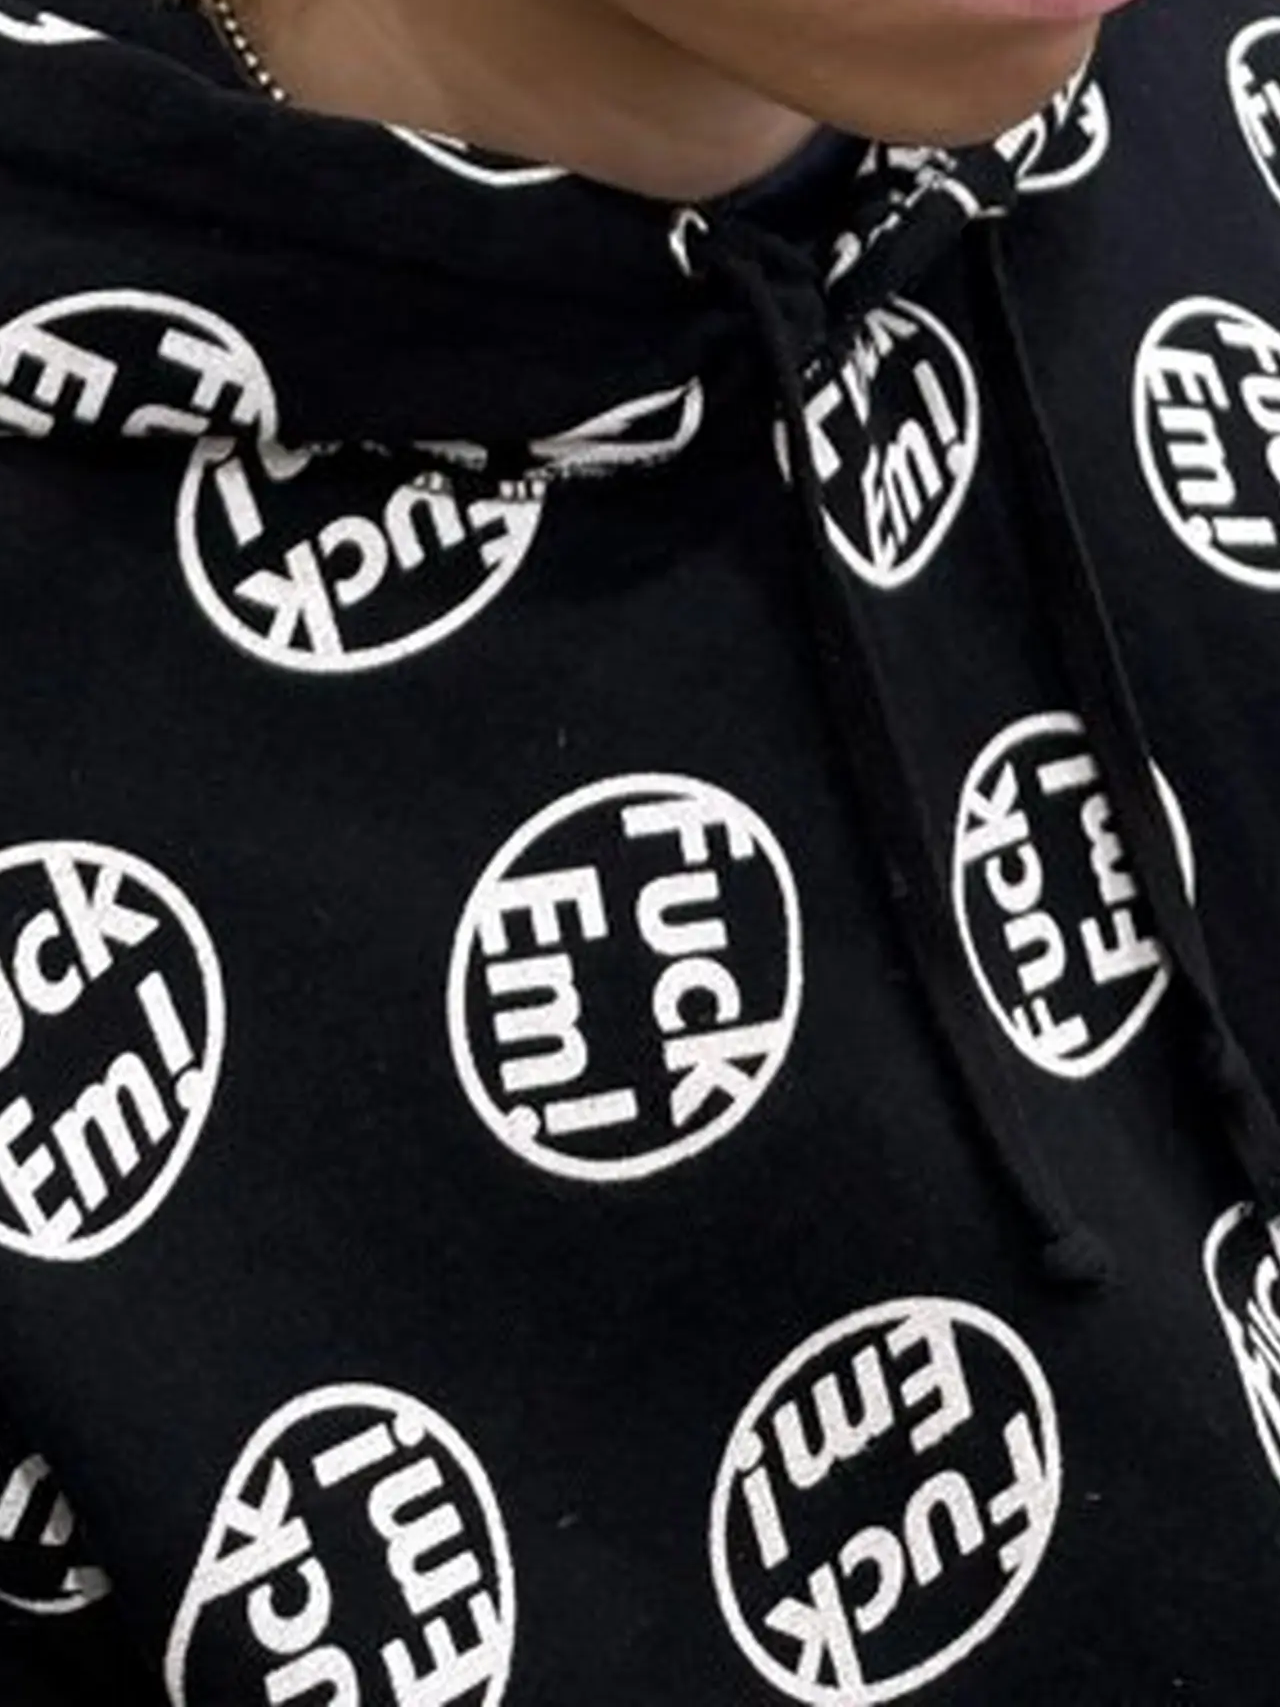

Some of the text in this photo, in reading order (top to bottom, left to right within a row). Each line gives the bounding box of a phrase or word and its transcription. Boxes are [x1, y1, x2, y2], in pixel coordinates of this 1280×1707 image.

[1144, 346, 1277, 547] Em!
[476, 866, 639, 1144] Em!
[623, 797, 785, 1127] Fuck
[962, 760, 1091, 1057] Fuck
[311, 1409, 508, 1707] Em!
[740, 1309, 974, 1568] Em!
[765, 1412, 1045, 1689] Fuck
